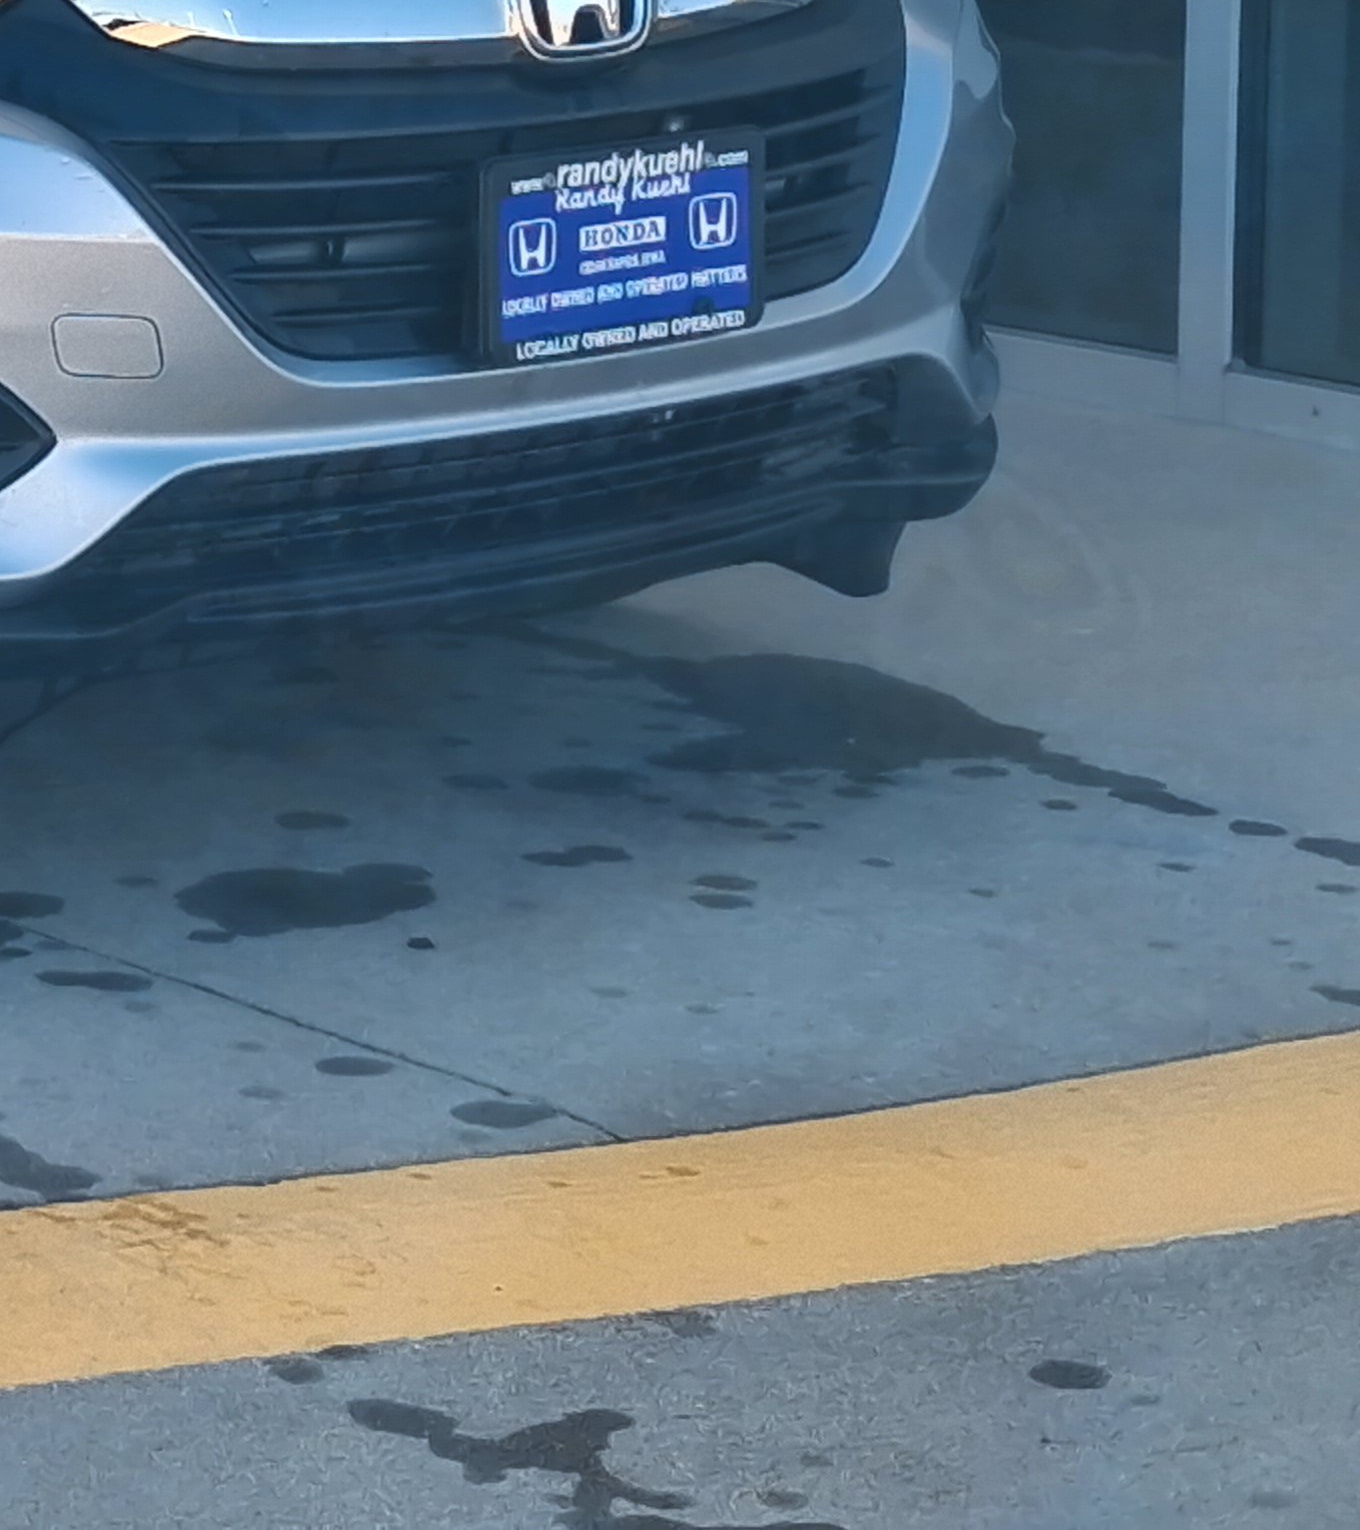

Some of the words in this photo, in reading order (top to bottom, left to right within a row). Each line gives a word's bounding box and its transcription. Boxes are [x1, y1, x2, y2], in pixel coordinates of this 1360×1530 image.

[555, 185, 626, 216] Randy
[631, 172, 691, 201] Kuehl
[583, 220, 662, 248] HONDA
[516, 333, 579, 362] LOCALLY
[582, 326, 636, 350] OWNED
[638, 321, 669, 342] AND
[671, 310, 746, 336] OPERATED
